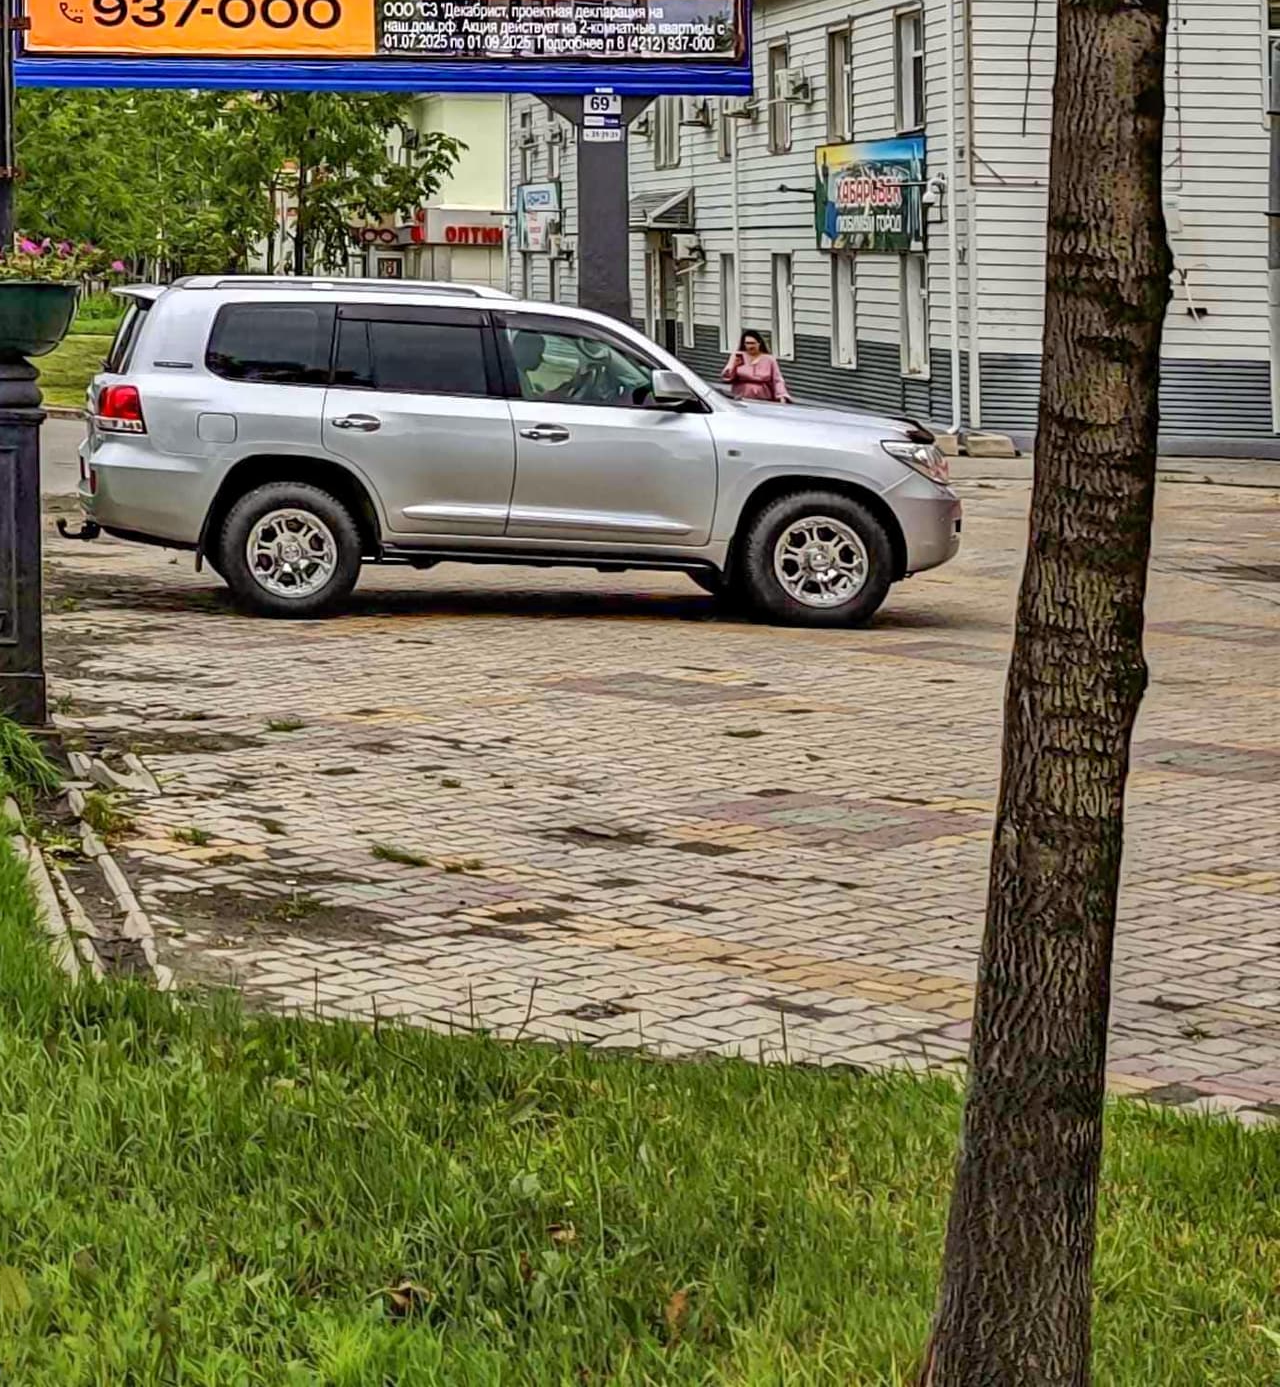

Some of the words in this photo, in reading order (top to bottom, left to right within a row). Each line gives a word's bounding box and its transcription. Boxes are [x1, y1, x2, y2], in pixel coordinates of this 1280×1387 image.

[383, 2, 414, 17] ООО
[511, 6, 573, 21] проектная
[575, 6, 648, 21] декларация
[649, 7, 664, 19] на
[462, 19, 497, 34] Акция
[500, 22, 559, 35] действует
[561, 23, 576, 34] на
[579, 20, 656, 35] 2-комнатные
[658, 23, 715, 37] квартиры
[716, 24, 725, 35] с
[383, 34, 448, 49] 01.07.2025
[450, 37, 465, 49] по
[536, 35, 604, 51] Подробнее
[616, 36, 625, 50] 8
[627, 36, 665, 52] (4212)
[667, 36, 716, 51] 937-000
[591, 96, 610, 111] 69
